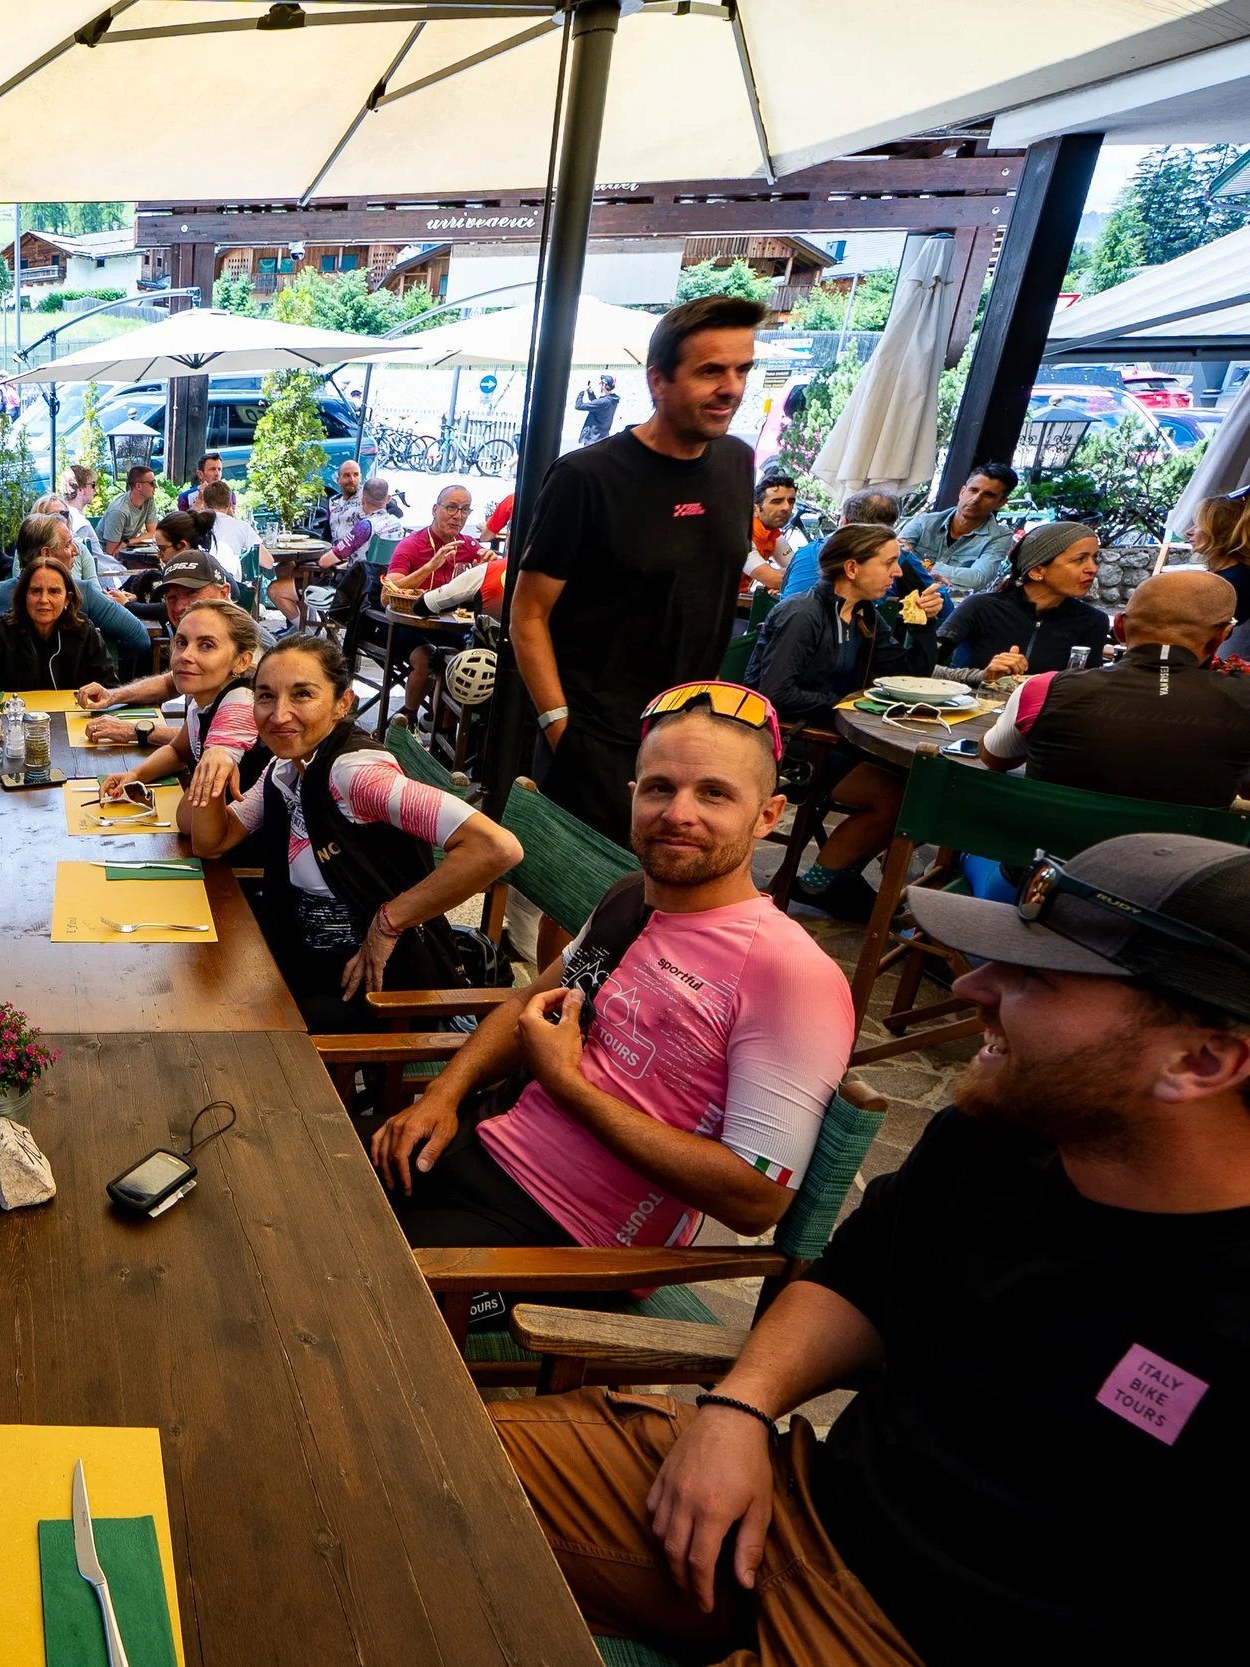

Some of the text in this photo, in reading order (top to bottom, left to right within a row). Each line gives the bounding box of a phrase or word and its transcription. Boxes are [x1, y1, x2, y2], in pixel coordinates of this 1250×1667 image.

[1096, 893, 1142, 914] RUDY
[657, 957, 705, 992] sportful
[599, 1030, 641, 1067] TOURS
[470, 1298, 499, 1316] OURS
[1138, 1360, 1185, 1391] ITALY
[1114, 1389, 1167, 1427] TOURS
[1130, 1378, 1169, 1407] BIKE
